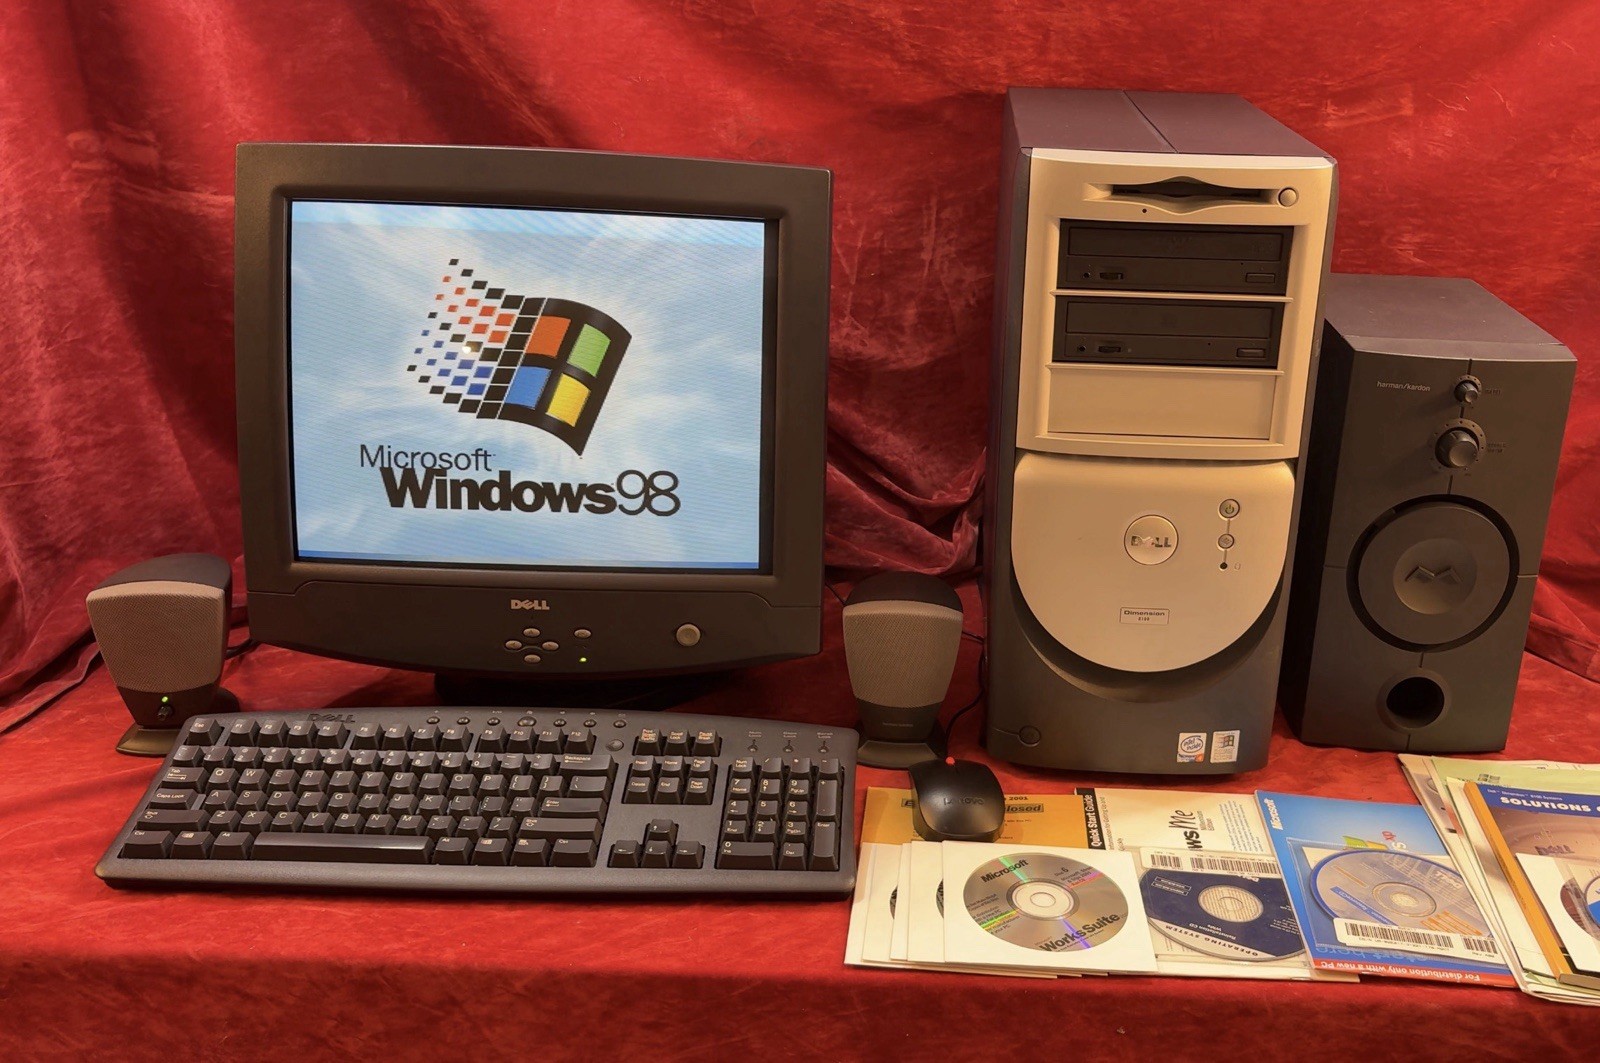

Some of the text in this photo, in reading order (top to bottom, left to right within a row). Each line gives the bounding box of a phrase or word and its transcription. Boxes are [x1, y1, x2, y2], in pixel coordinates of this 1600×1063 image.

[1376, 381, 1430, 392] harman/kardon
[360, 444, 492, 472] Microsoft
[510, 599, 550, 610] DELL
[1500, 796, 1591, 812] SOLUTIONS
[1084, 795, 1102, 847] Quick Start Guide
[1263, 798, 1283, 831] Microsoft
[981, 859, 1029, 883] Microsoft
[1165, 925, 1199, 939] SYSTEM
[1365, 964, 1386, 972] with
[1388, 966, 1407, 974] only
[1410, 969, 1462, 982] distribution
